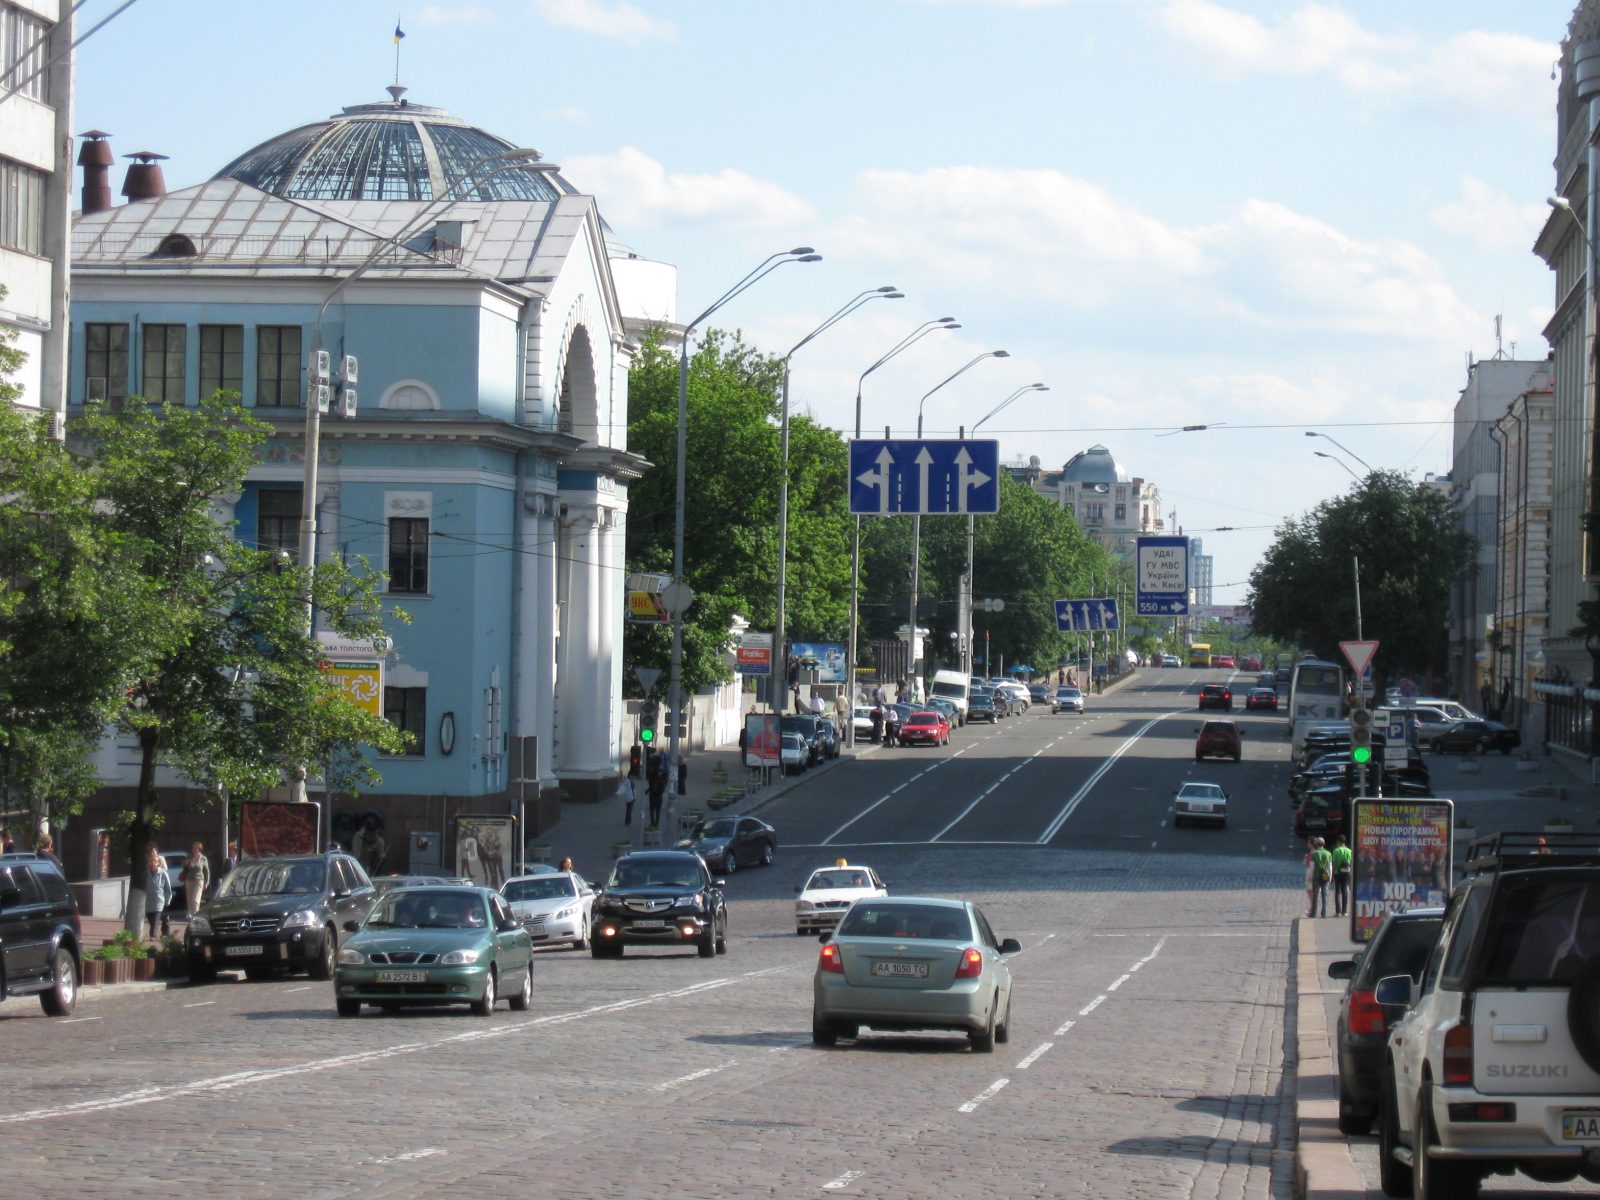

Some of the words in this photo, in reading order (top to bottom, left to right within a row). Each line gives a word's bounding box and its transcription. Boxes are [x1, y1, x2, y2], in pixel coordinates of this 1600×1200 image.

[1146, 561, 1157, 569] ГУ
[1161, 561, 1180, 569] МВС
[1147, 571, 1179, 580] України
[1140, 603, 1158, 612] 550
[1364, 826, 1392, 836] НОВАЯ
[1393, 826, 1440, 836] ПРОГРАММА
[1362, 837, 1379, 846] ШОУ
[1383, 881, 1416, 900] ХОР
[878, 963, 890, 973] AA
[892, 964, 912, 974] 1050
[1485, 1064, 1569, 1078] SUZUKI
[1574, 1118, 1600, 1137] AA
